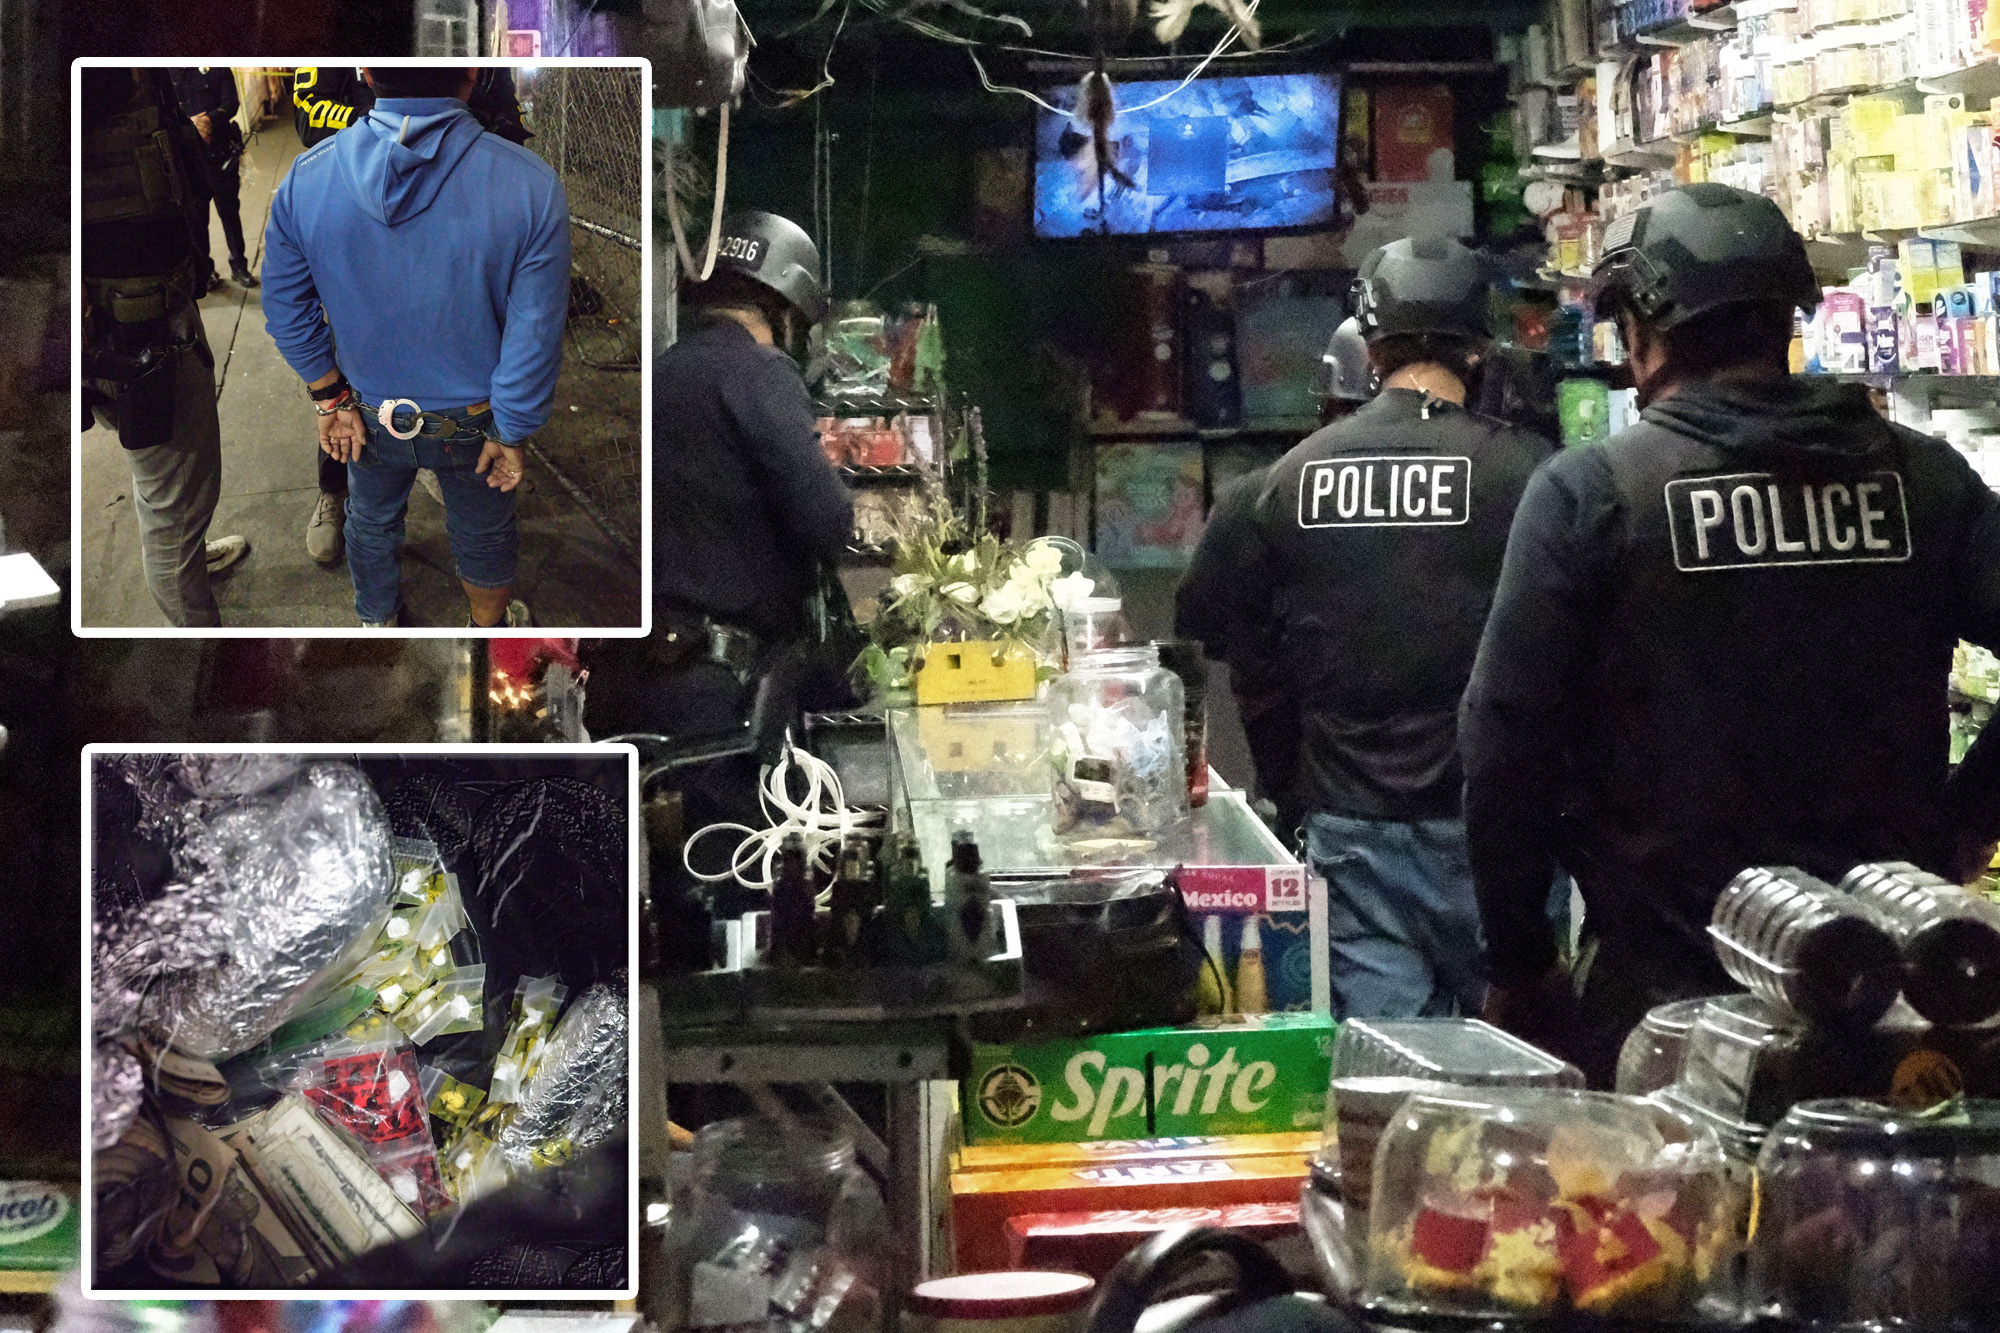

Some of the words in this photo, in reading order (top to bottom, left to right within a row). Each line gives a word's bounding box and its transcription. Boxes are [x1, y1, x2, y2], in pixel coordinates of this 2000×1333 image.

[1312, 464, 1455, 519] POLICE
[1690, 482, 1892, 560] POLICE
[1182, 889, 1258, 907] Mexico
[1271, 878, 1299, 898] 12
[1050, 1043, 1276, 1137] Sprite
